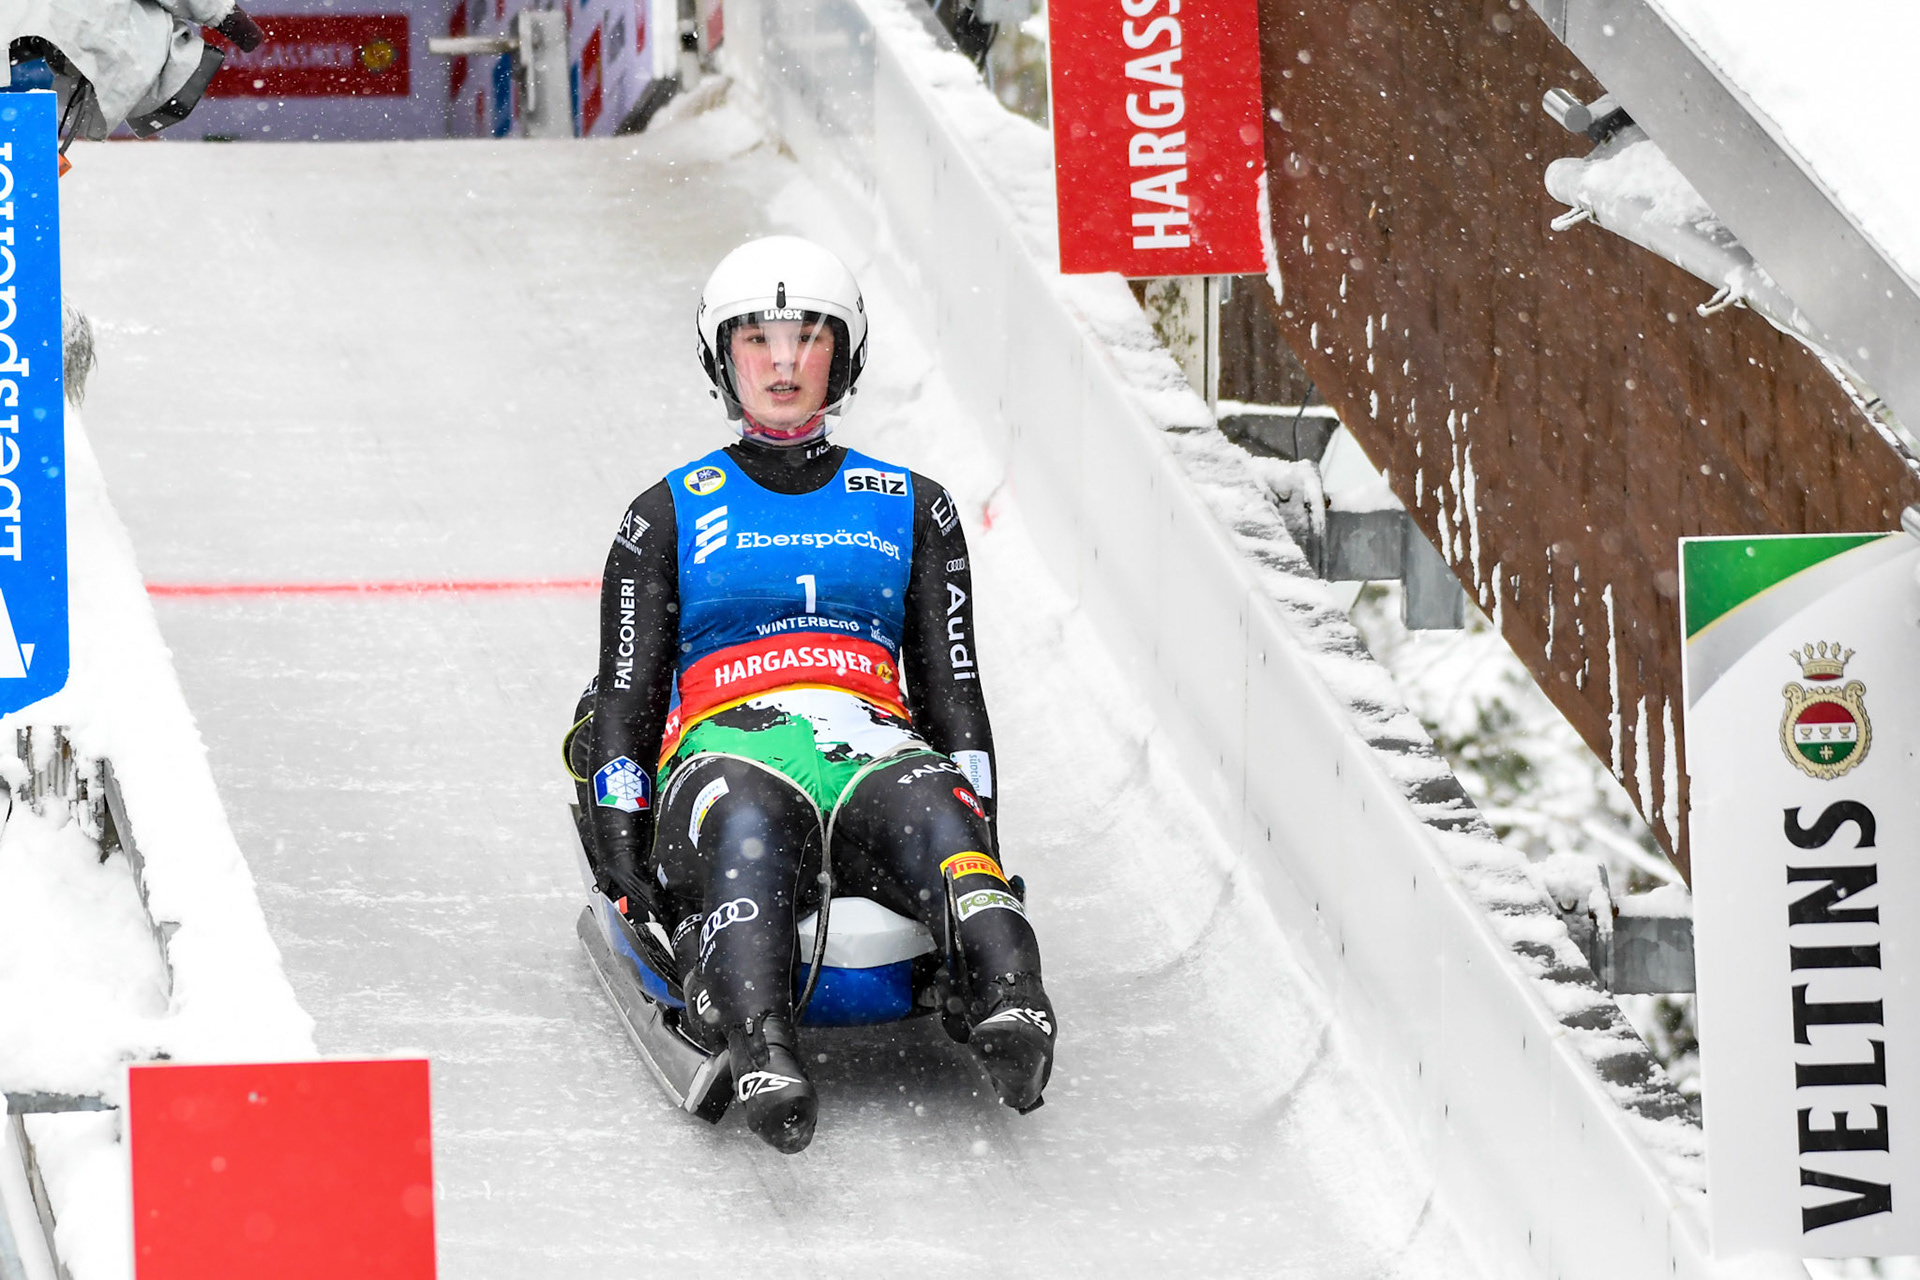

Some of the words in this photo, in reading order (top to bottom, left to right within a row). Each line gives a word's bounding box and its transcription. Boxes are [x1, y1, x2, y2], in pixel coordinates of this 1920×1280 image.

[764, 308, 803, 321] uvex
[736, 529, 900, 561] Eberspächer
[796, 574, 817, 614] 1
[614, 577, 636, 690] FALCONERI
[755, 616, 860, 636] WINTERBERG
[945, 582, 977, 682] Audi
[714, 646, 873, 688] HARGASSNER
[603, 760, 643, 777] FISI
[1783, 799, 1893, 1236] VELTINS
